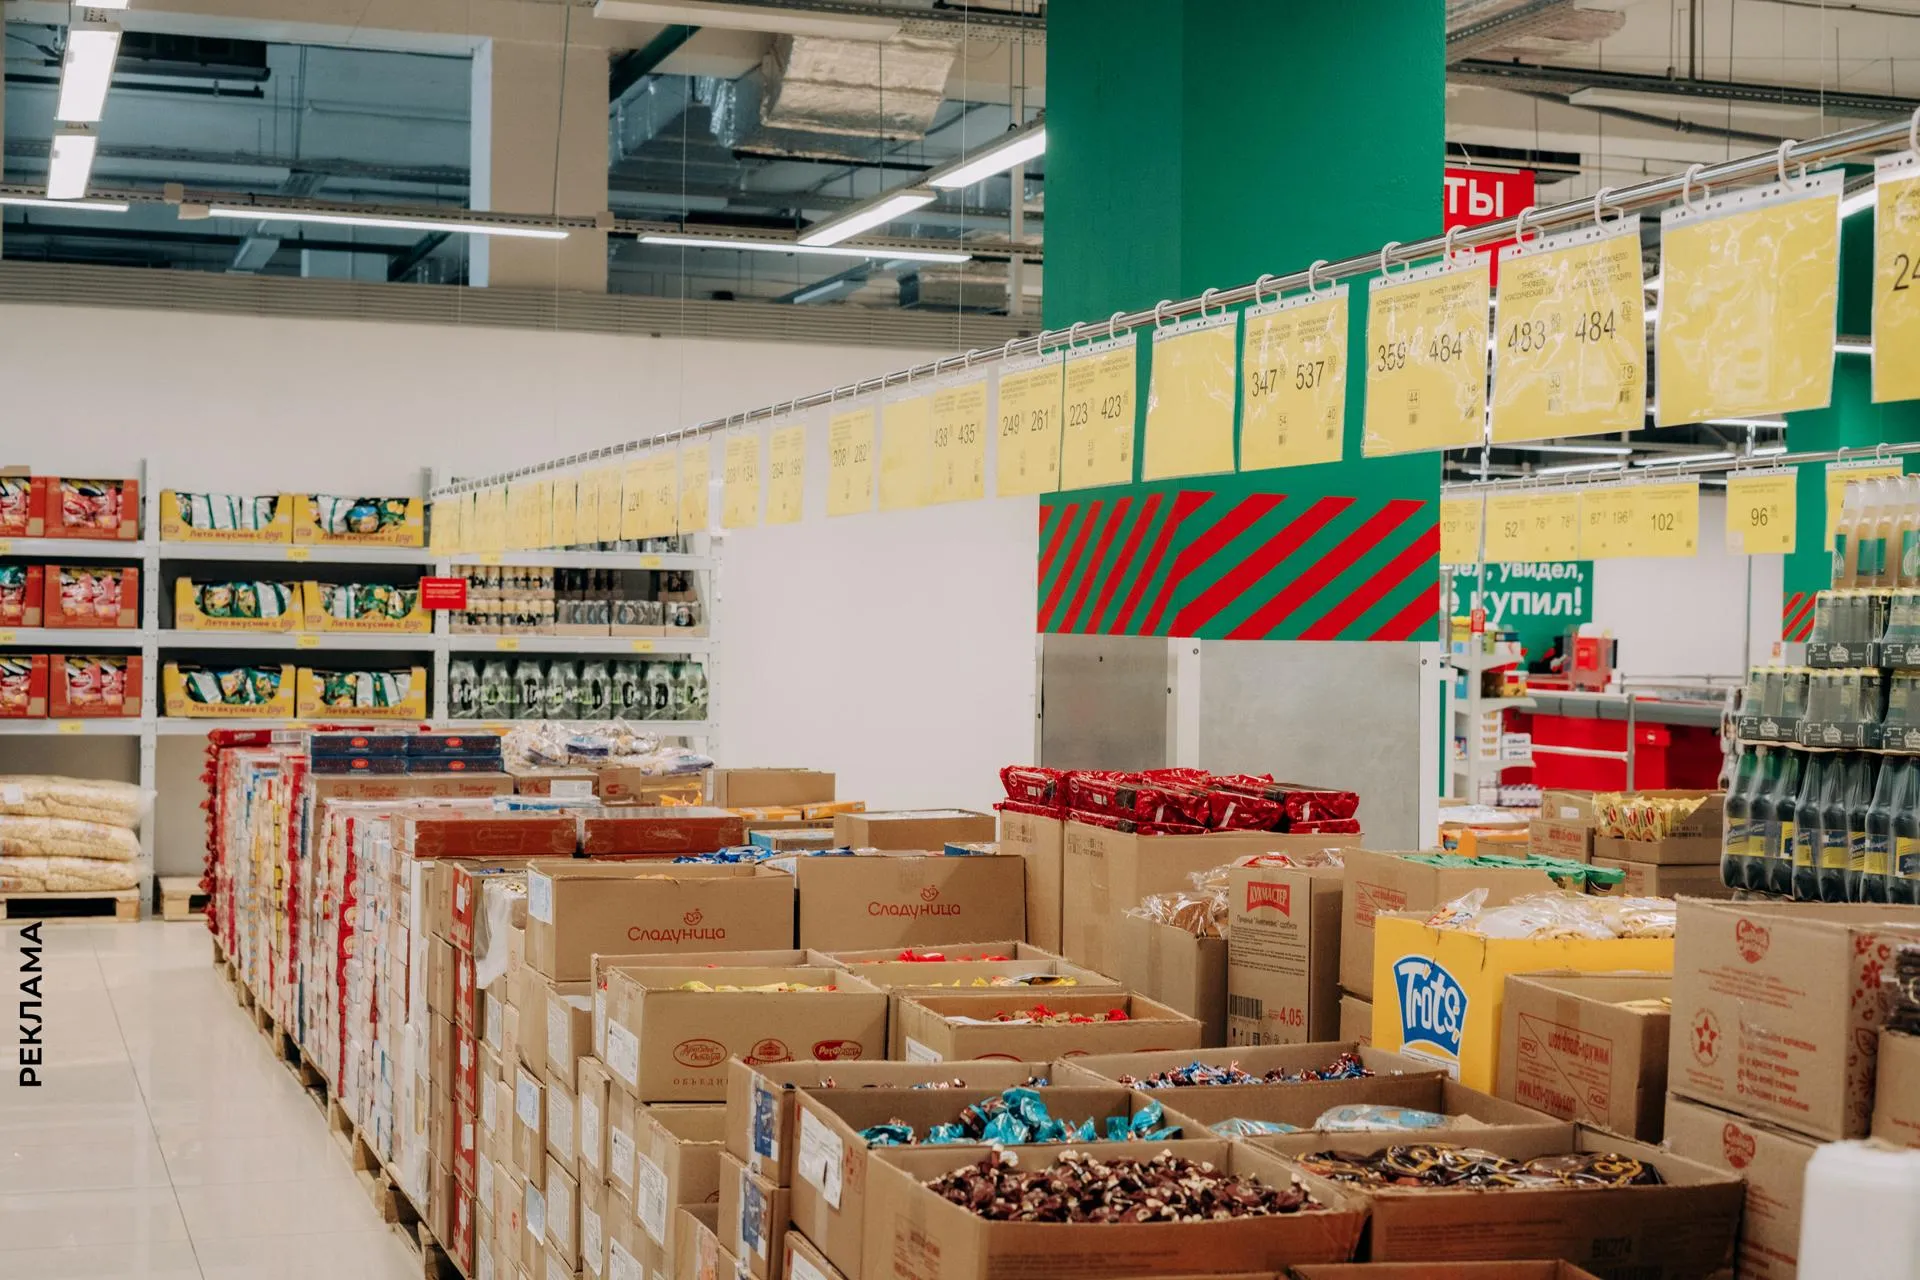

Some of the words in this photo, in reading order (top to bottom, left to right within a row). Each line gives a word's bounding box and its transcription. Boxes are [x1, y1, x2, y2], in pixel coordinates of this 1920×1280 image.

[1508, 320, 1546, 354] 483
[1575, 309, 1616, 344] 484
[1377, 342, 1406, 373] 359
[1429, 332, 1463, 363] 484
[1252, 368, 1277, 397] 347
[1295, 360, 1325, 390] 537
[1069, 402, 1088, 427] 223
[1101, 394, 1121, 419] 423
[1003, 414, 1020, 436] 249
[1031, 408, 1049, 432] 261
[957, 423, 976, 444] 435
[1651, 512, 1674, 531] 102
[1751, 507, 1768, 527] 96
[1505, 521, 1518, 538] 52
[1470, 586, 1582, 627] купил!
[868, 901, 961, 920] Сладуница
[627, 926, 726, 944] Сладуница
[673, 1077, 729, 1087] ОБЪЕДИ
